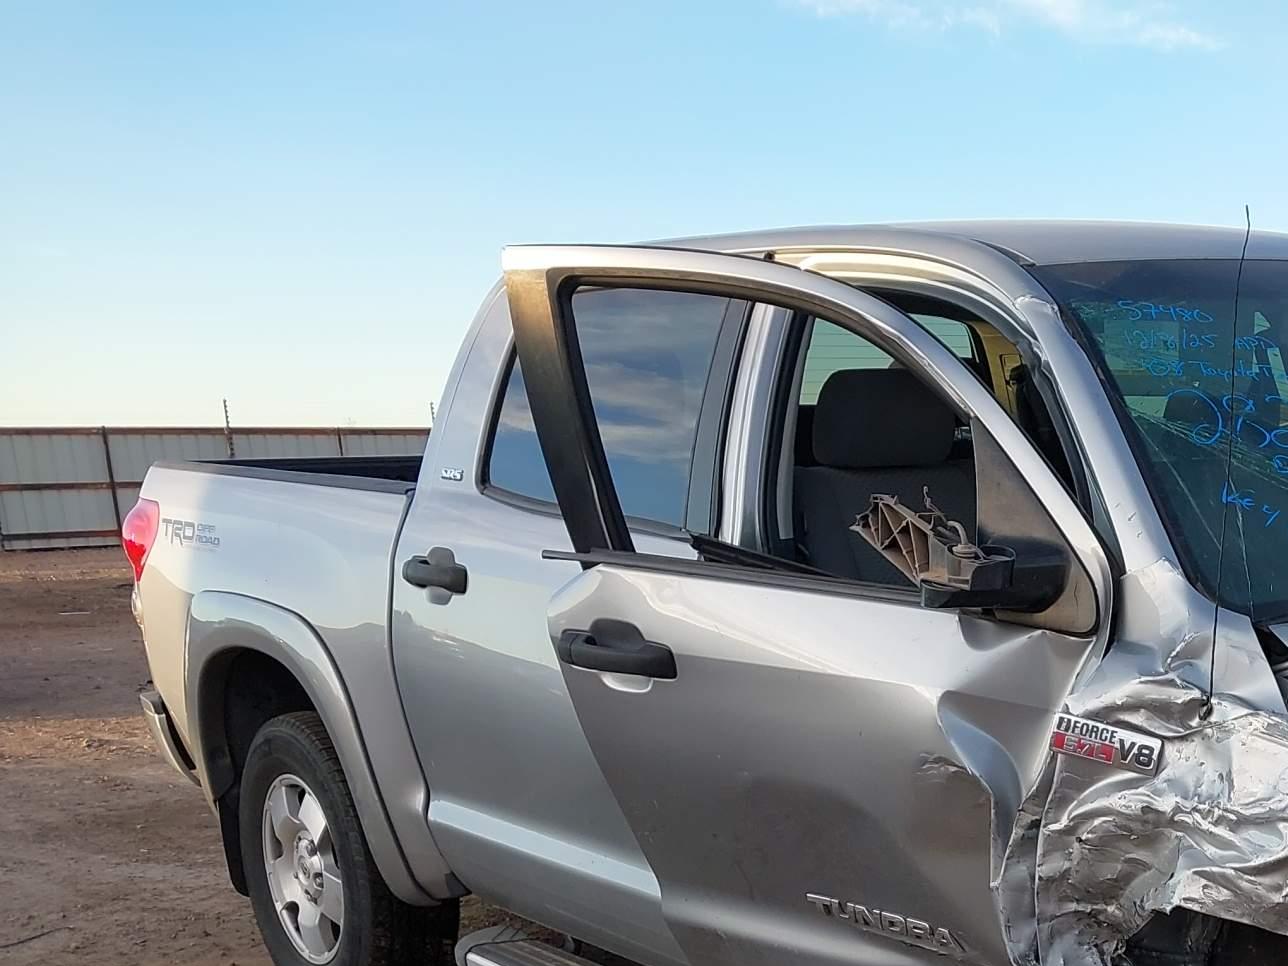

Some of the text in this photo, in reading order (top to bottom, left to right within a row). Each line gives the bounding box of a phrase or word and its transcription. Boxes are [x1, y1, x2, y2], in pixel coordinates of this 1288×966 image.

[1117, 301, 1214, 323] 57480
[161, 518, 195, 546] TRD
[1119, 738, 1156, 769] V8
[806, 893, 968, 953] TUNDRA
